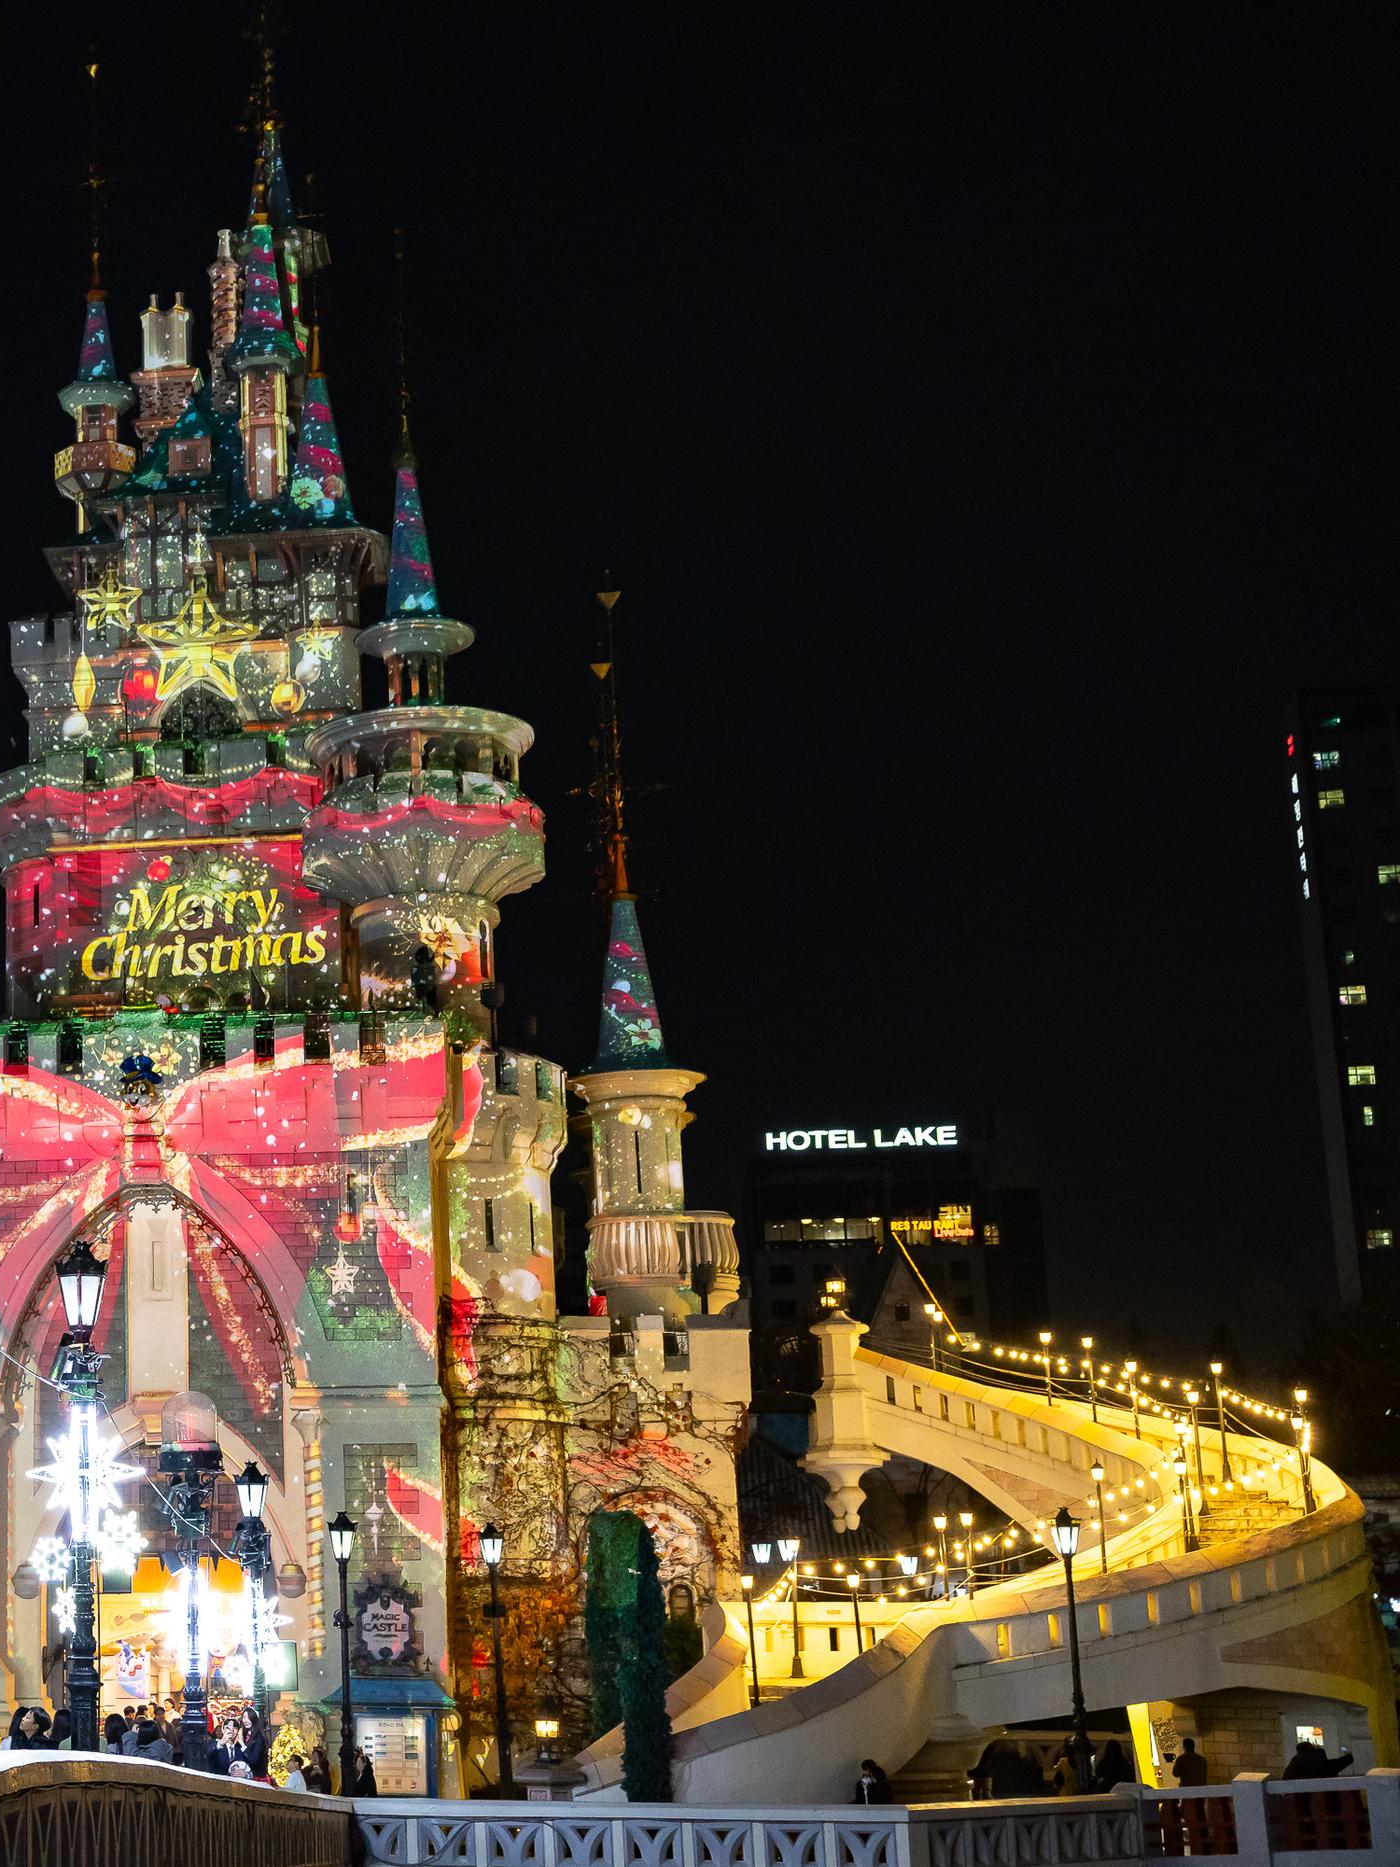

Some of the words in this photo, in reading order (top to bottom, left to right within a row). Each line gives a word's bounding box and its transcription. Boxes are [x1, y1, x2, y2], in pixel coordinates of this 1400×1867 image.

[123, 884, 278, 934] Merry
[81, 929, 328, 981] Christmas
[765, 1129, 867, 1151] HOTEL
[874, 1125, 958, 1148] LAKE
[364, 1623, 408, 1633] CASTLE
[370, 1613, 401, 1622] MAGIC
